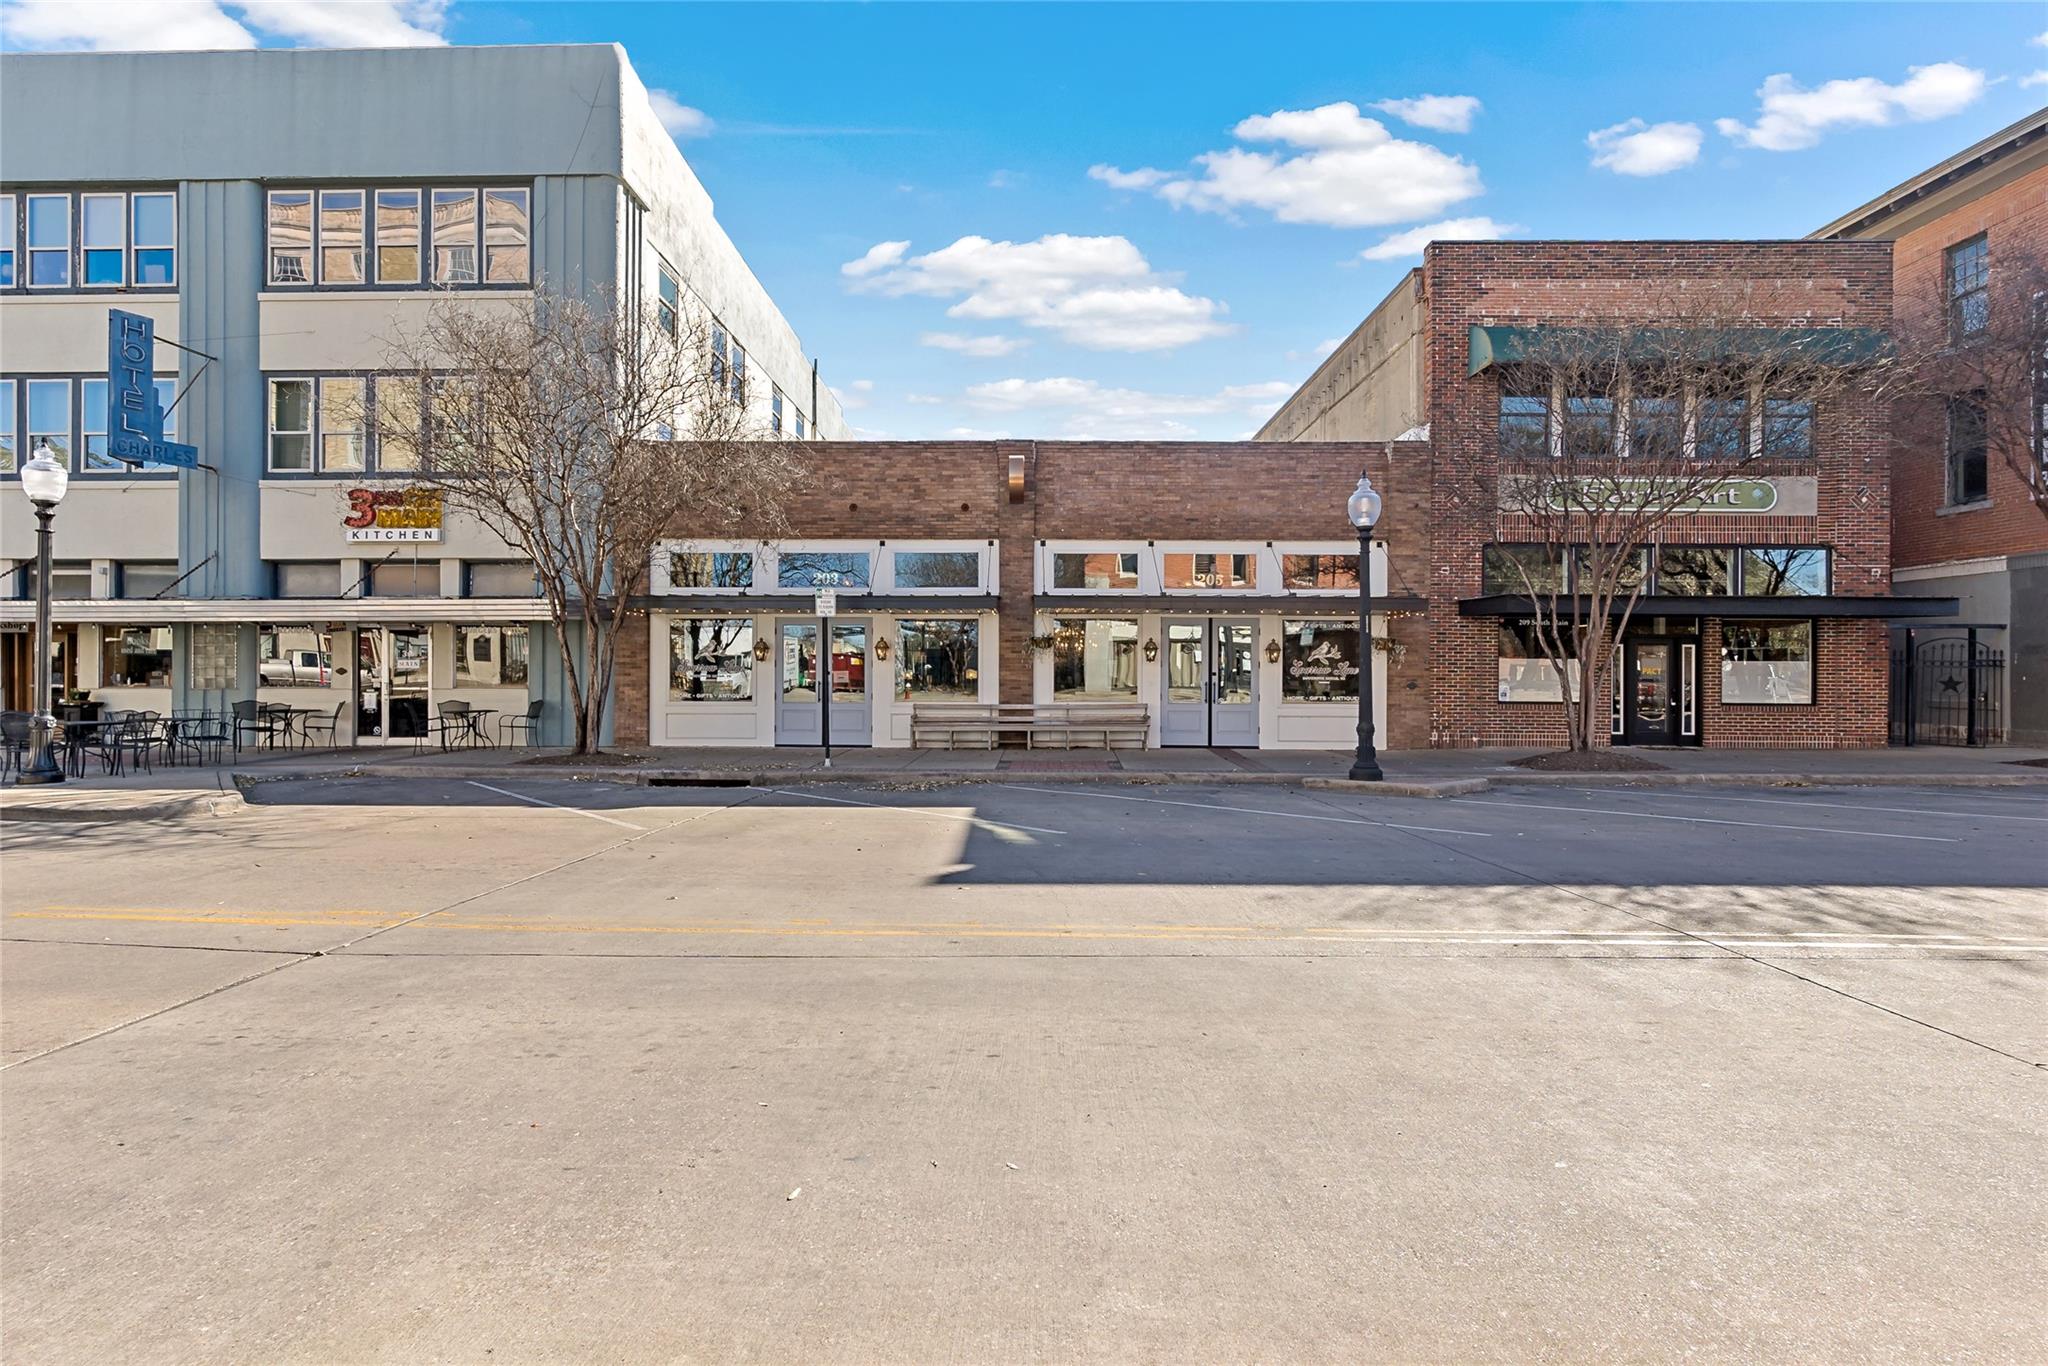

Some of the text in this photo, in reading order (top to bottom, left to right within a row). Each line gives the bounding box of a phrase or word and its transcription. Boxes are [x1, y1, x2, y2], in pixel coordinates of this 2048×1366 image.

[120, 318, 150, 442] HOTEL
[116, 438, 194, 464] CHARLES
[352, 530, 433, 539] KITCHEN
[813, 572, 838, 585] 203
[1197, 573, 1224, 586] 205
[1290, 659, 1331, 677] Sparrow
